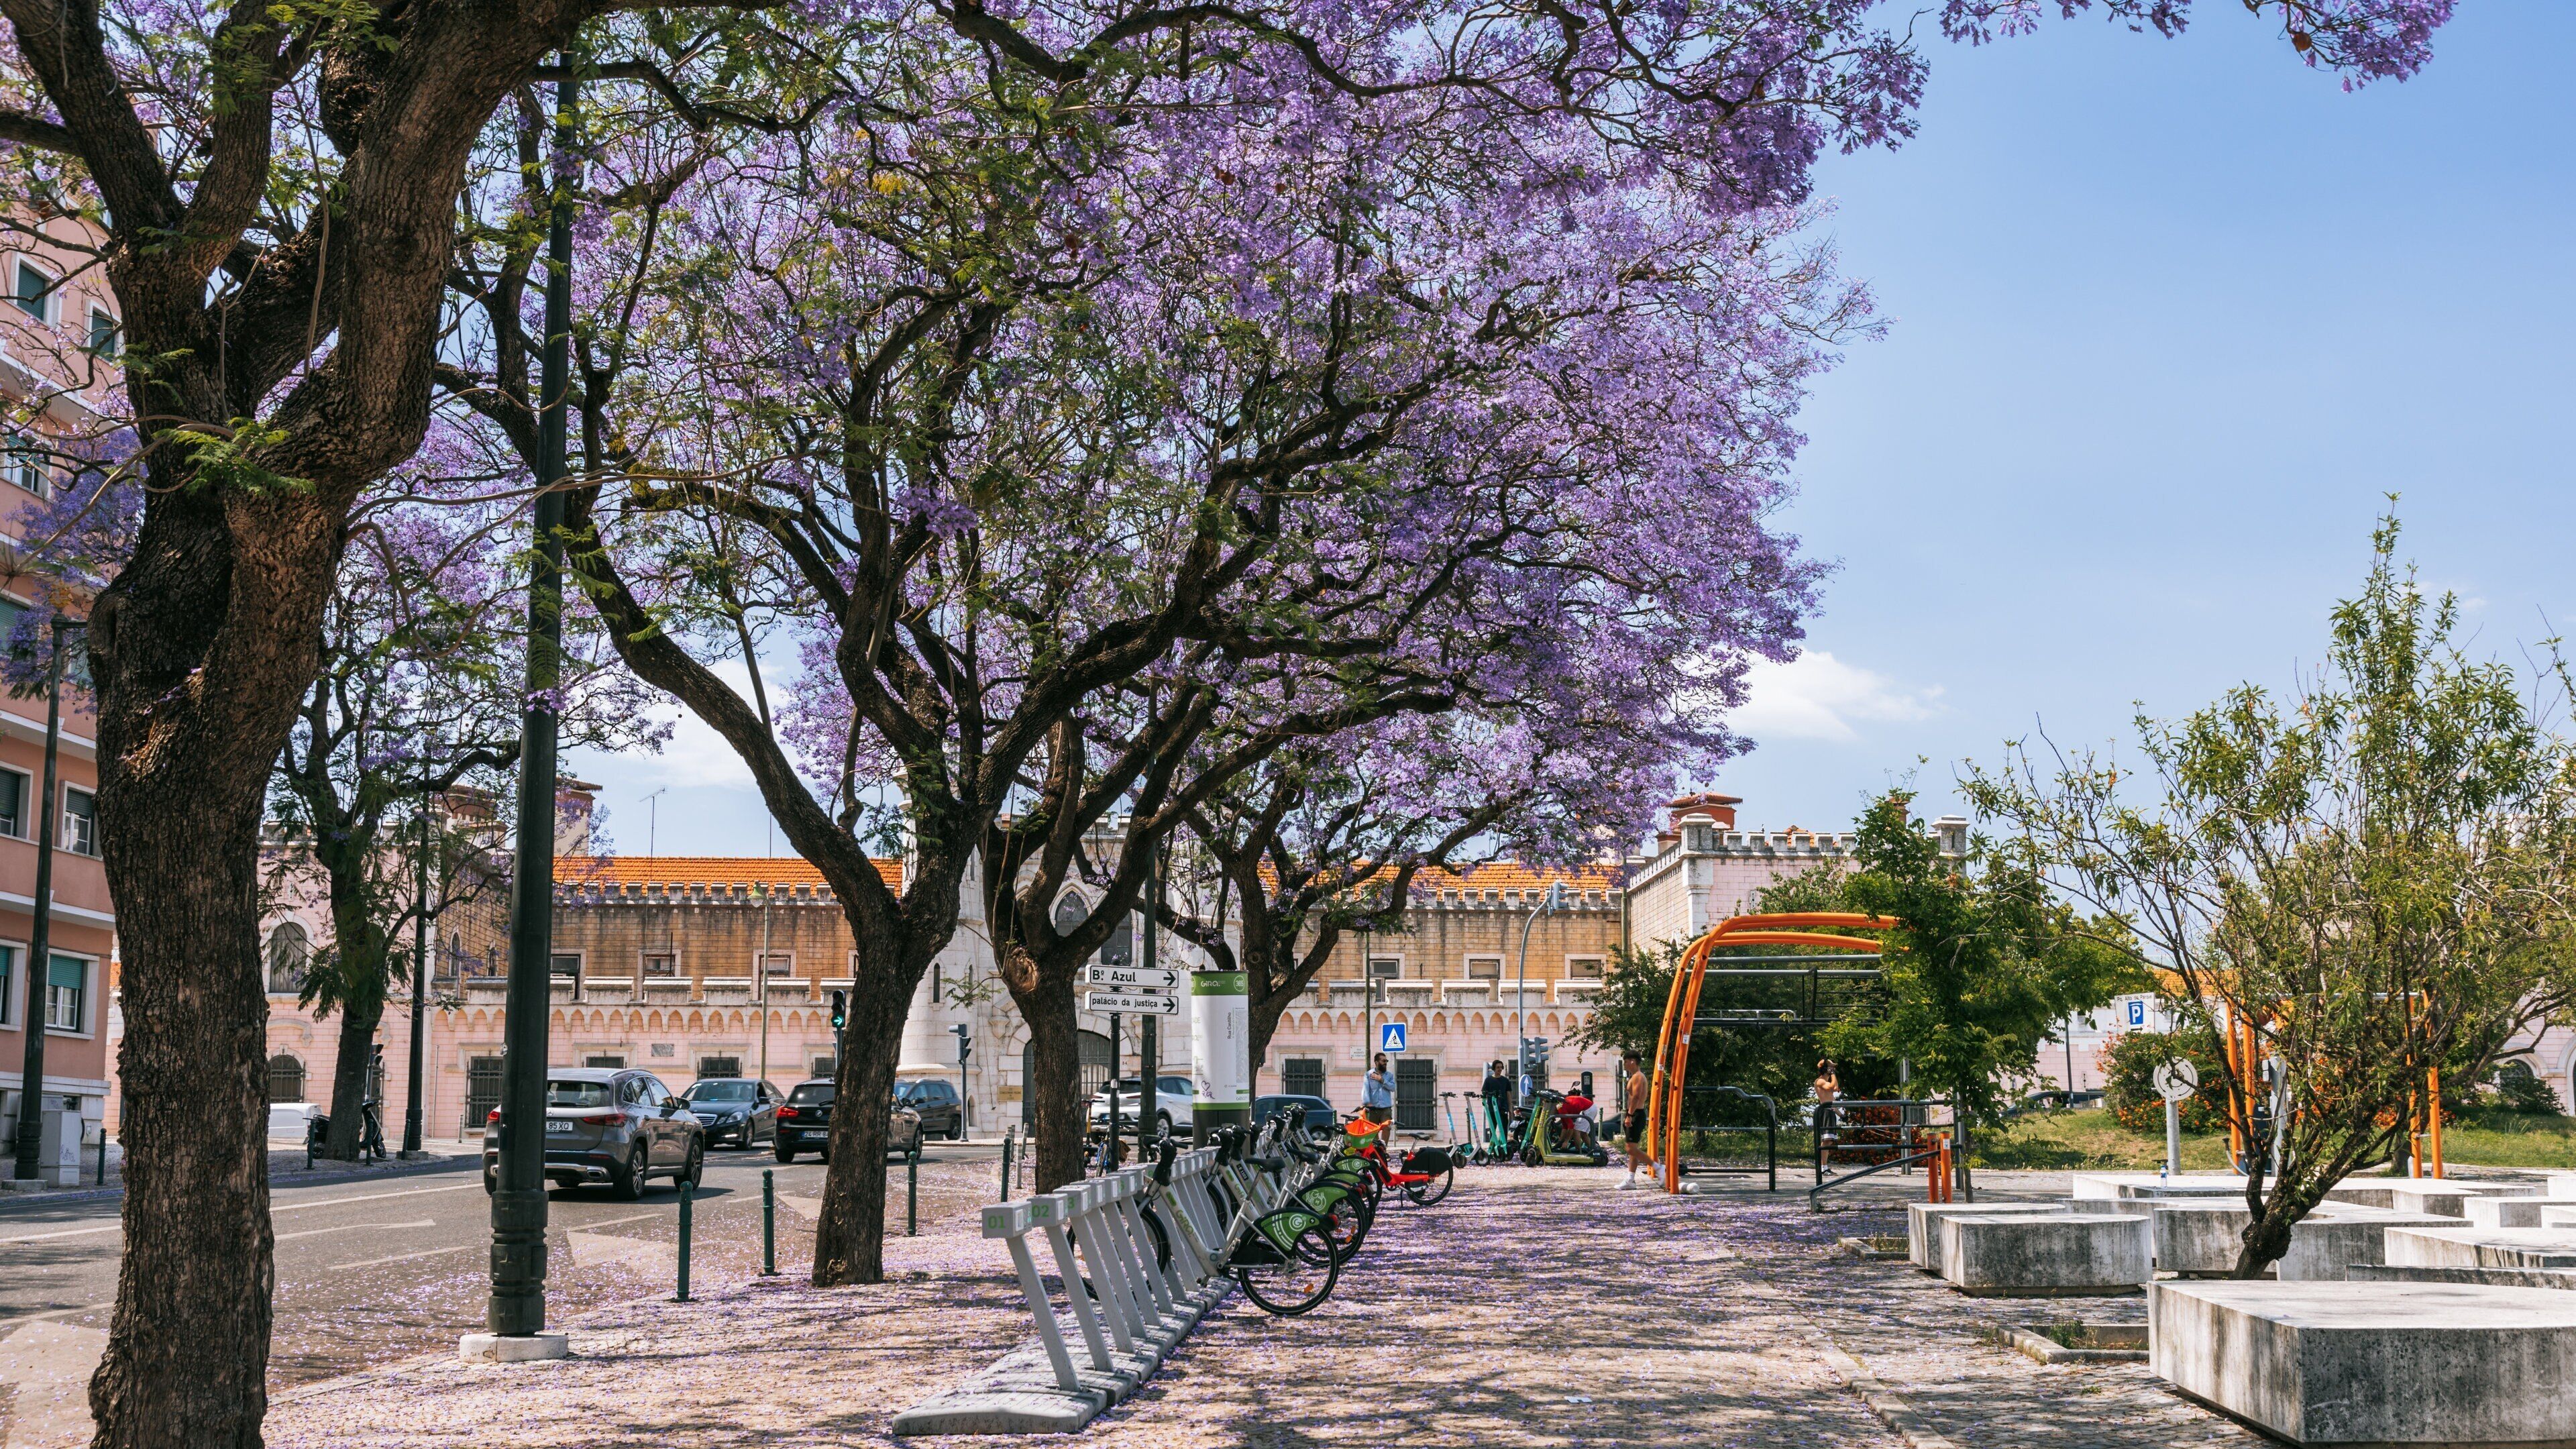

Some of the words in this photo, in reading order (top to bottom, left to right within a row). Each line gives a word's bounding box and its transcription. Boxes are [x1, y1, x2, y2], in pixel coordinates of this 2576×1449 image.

[1112, 971, 1136, 982] Azul
[1092, 998, 1118, 1006] palácio
[1122, 998, 1130, 1006] da
[1134, 999, 1158, 1009] justiça
[2131, 1006, 2141, 1023] P
[1032, 1205, 1049, 1218] 02
[987, 1216, 1006, 1229] 01
